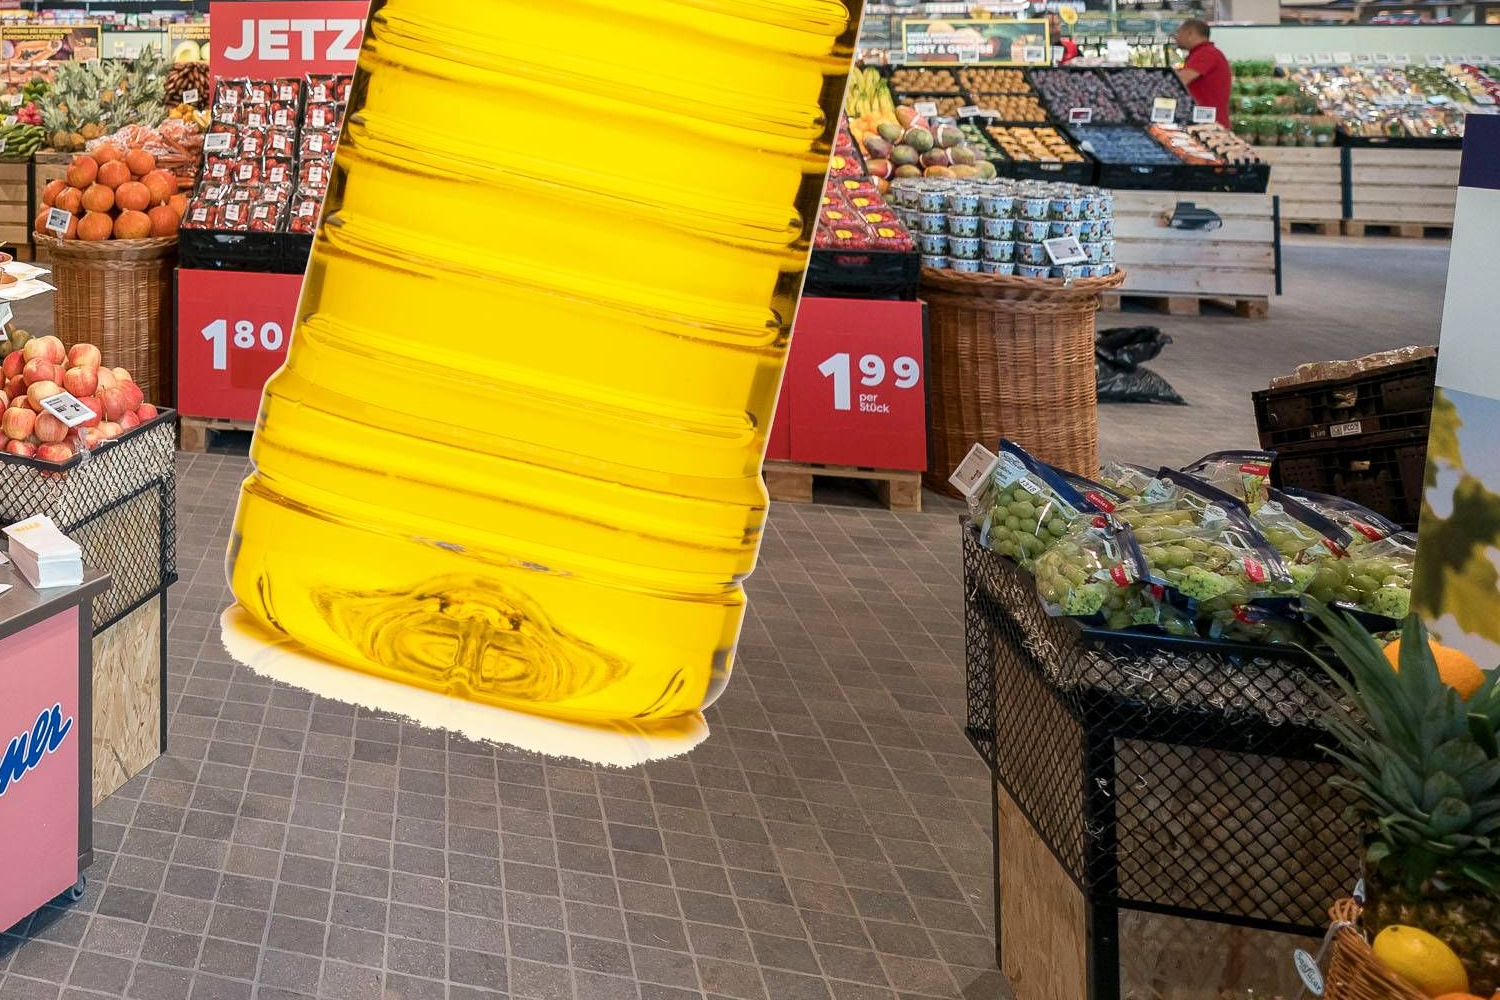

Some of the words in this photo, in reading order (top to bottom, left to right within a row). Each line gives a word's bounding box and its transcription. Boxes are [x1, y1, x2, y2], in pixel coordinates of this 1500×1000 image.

[224, 19, 366, 61] JETZ
[859, 393, 878, 403] per
[859, 402, 889, 414] Stück
